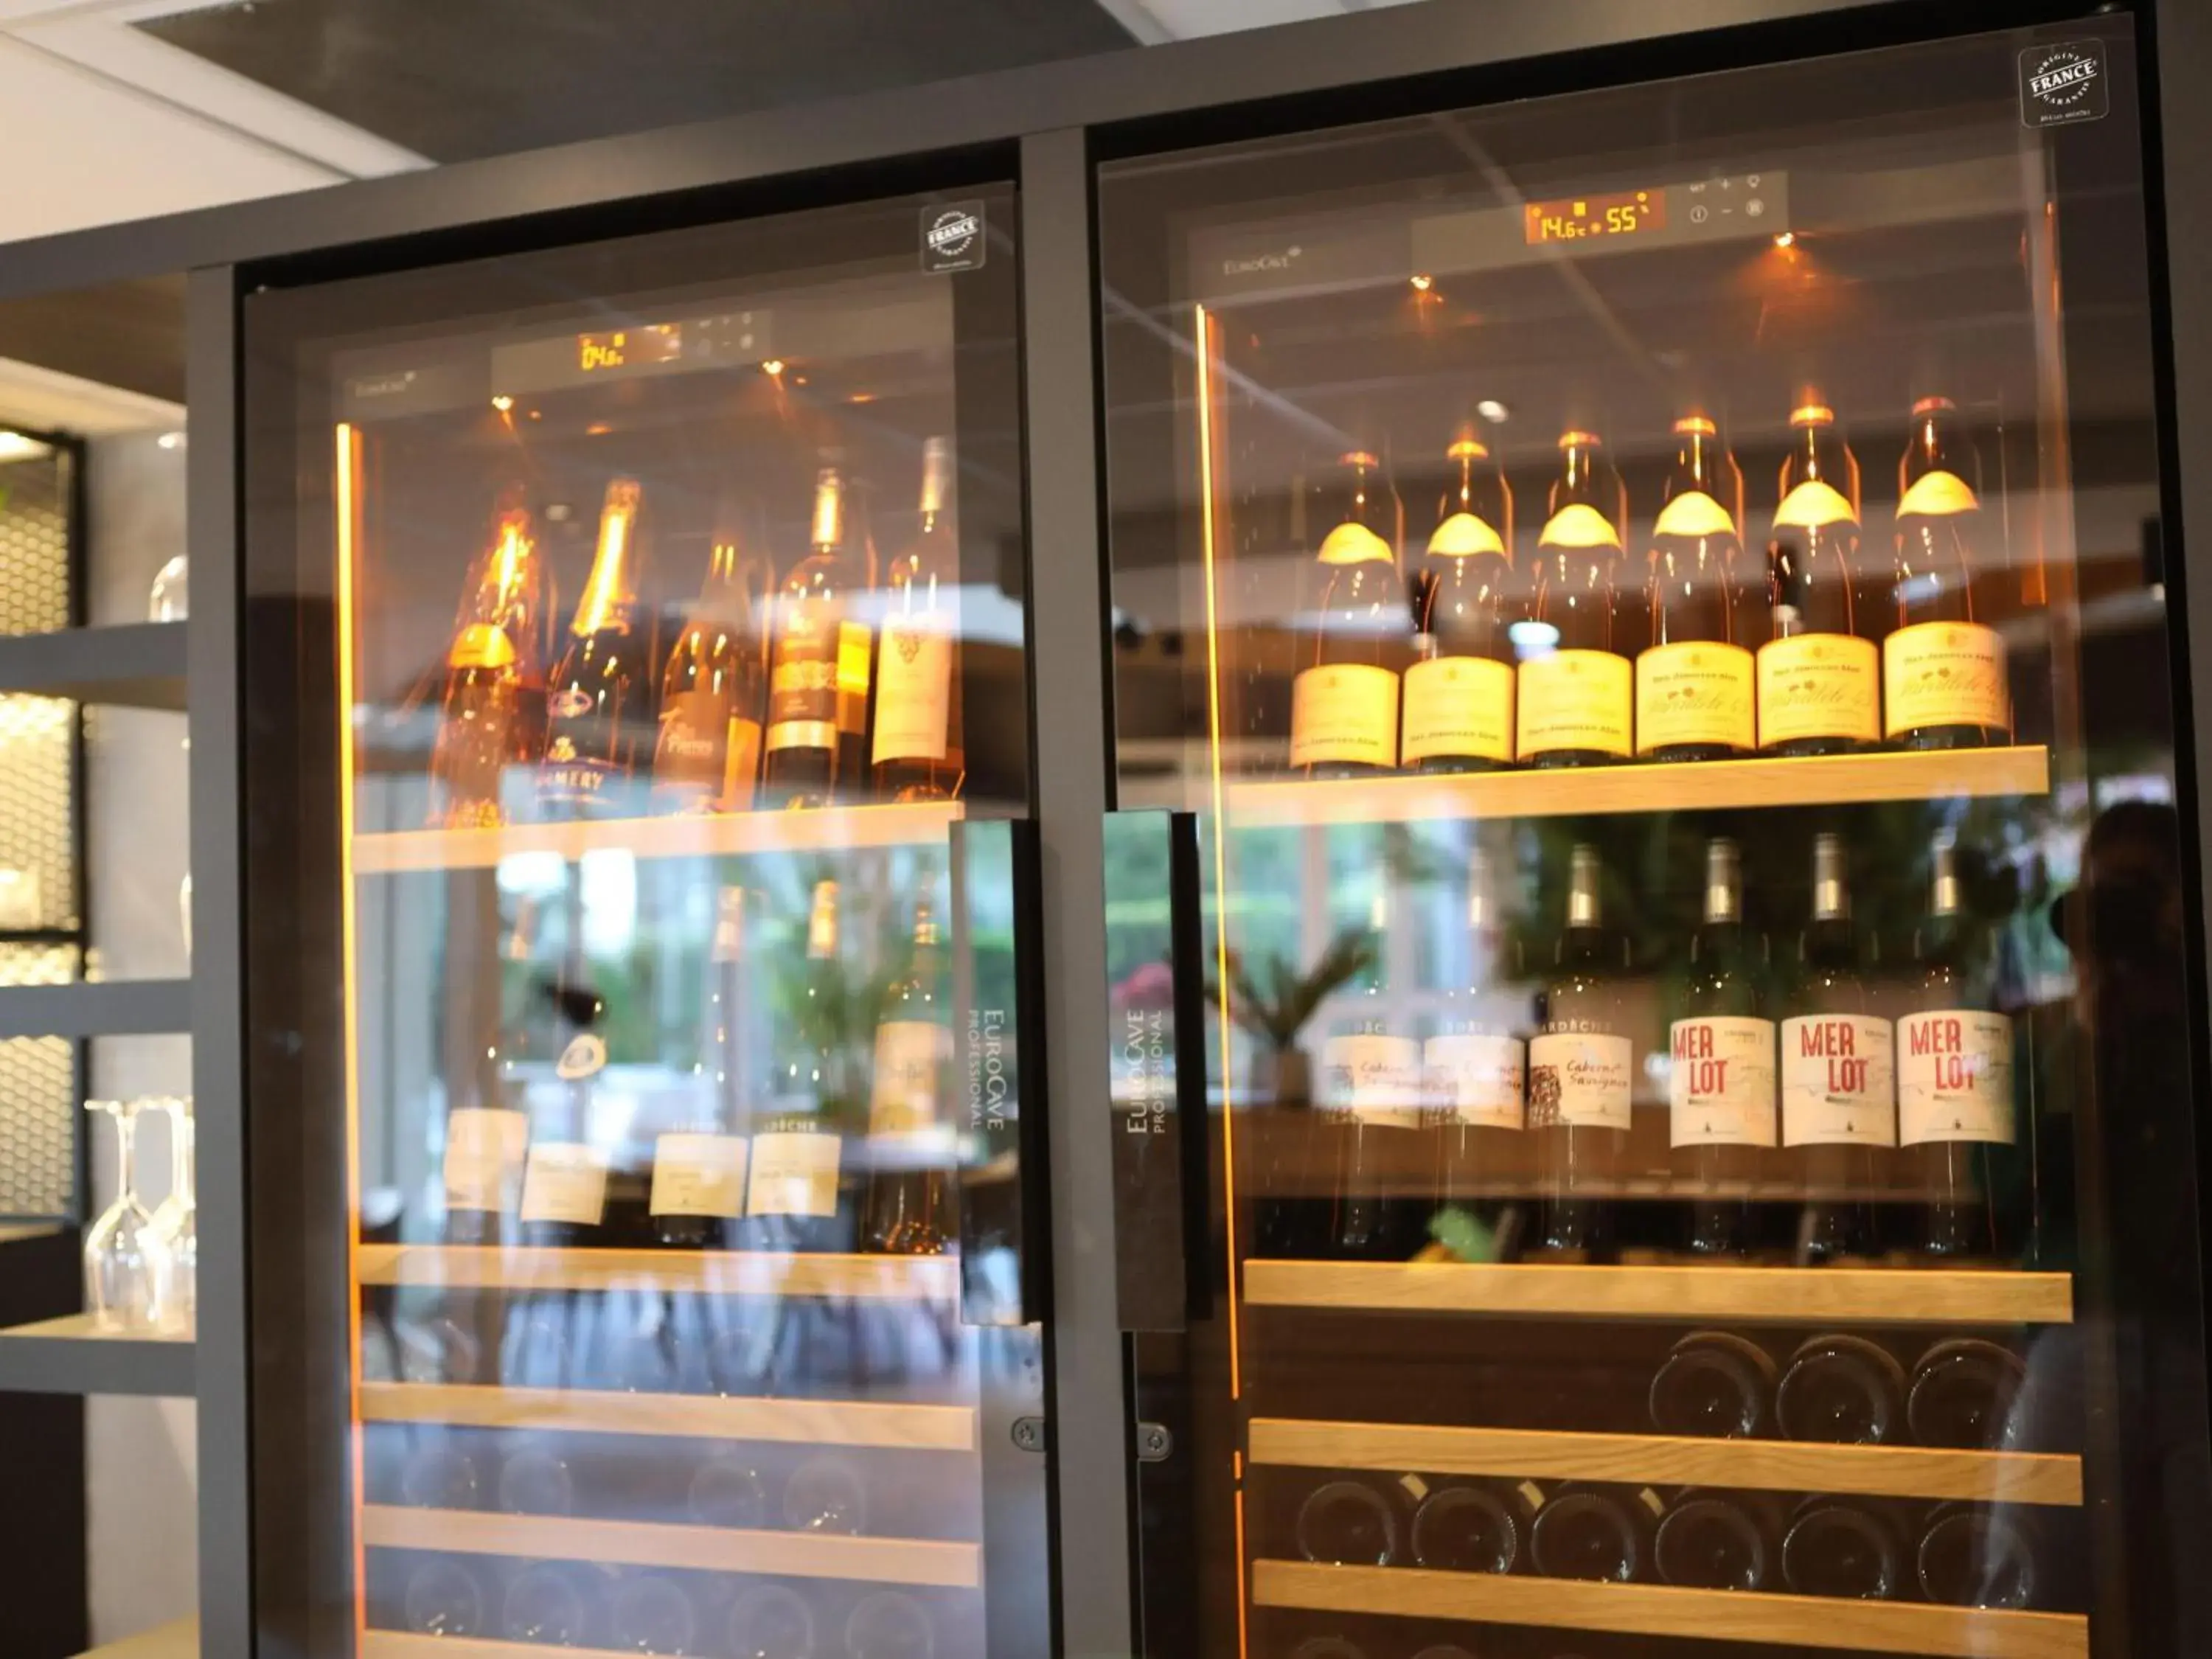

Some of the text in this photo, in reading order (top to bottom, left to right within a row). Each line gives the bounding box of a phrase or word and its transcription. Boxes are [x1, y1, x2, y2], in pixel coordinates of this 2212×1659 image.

[2031, 61, 2095, 93] FRANCE
[1606, 205, 1636, 233] 55
[1673, 1025, 1714, 1062] MER
[1801, 1022, 1855, 1058] MER
[1910, 1018, 1962, 1056] MER
[1689, 1060, 1728, 1095] LOT
[1827, 1059, 1868, 1094] LOT
